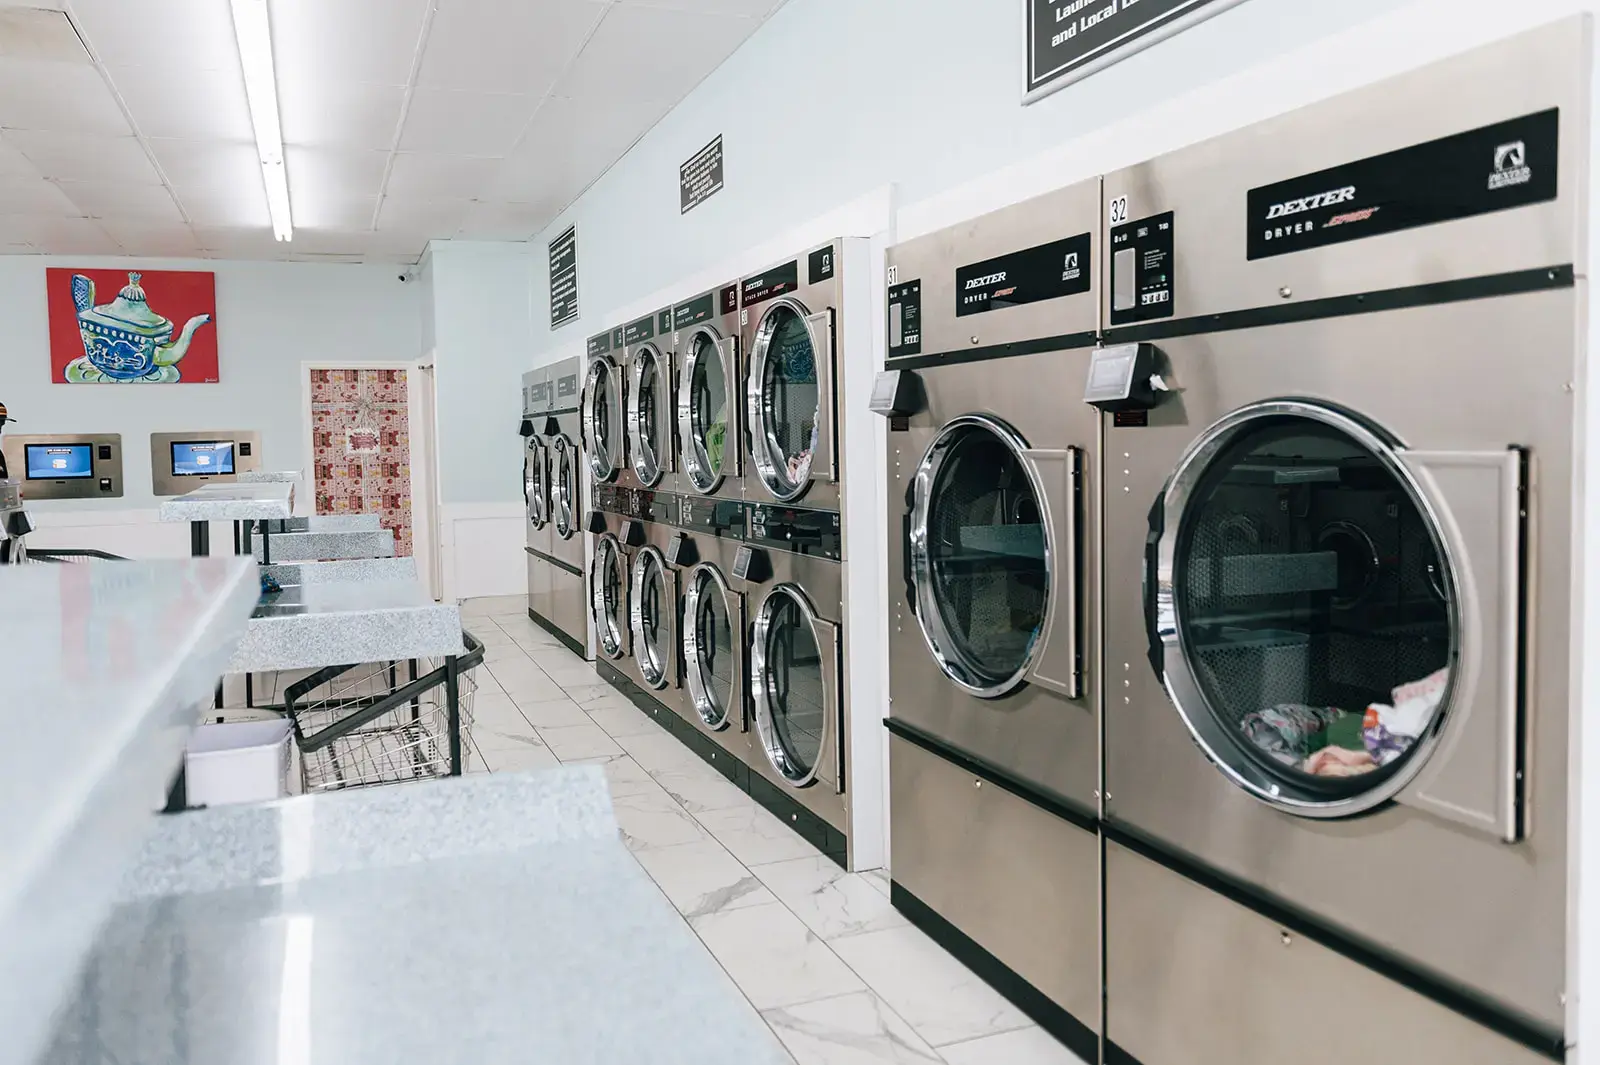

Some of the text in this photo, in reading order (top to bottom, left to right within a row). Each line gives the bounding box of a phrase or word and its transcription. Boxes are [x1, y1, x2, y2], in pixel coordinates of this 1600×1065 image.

[1051, 0, 1117, 47] and Local
[1112, 198, 1126, 222] 32
[1265, 185, 1356, 219] DEXTER
[1264, 220, 1313, 240] DRYER
[889, 267, 897, 284] 31
[964, 271, 1007, 290] DEXTER
[964, 292, 988, 304] DRYER
